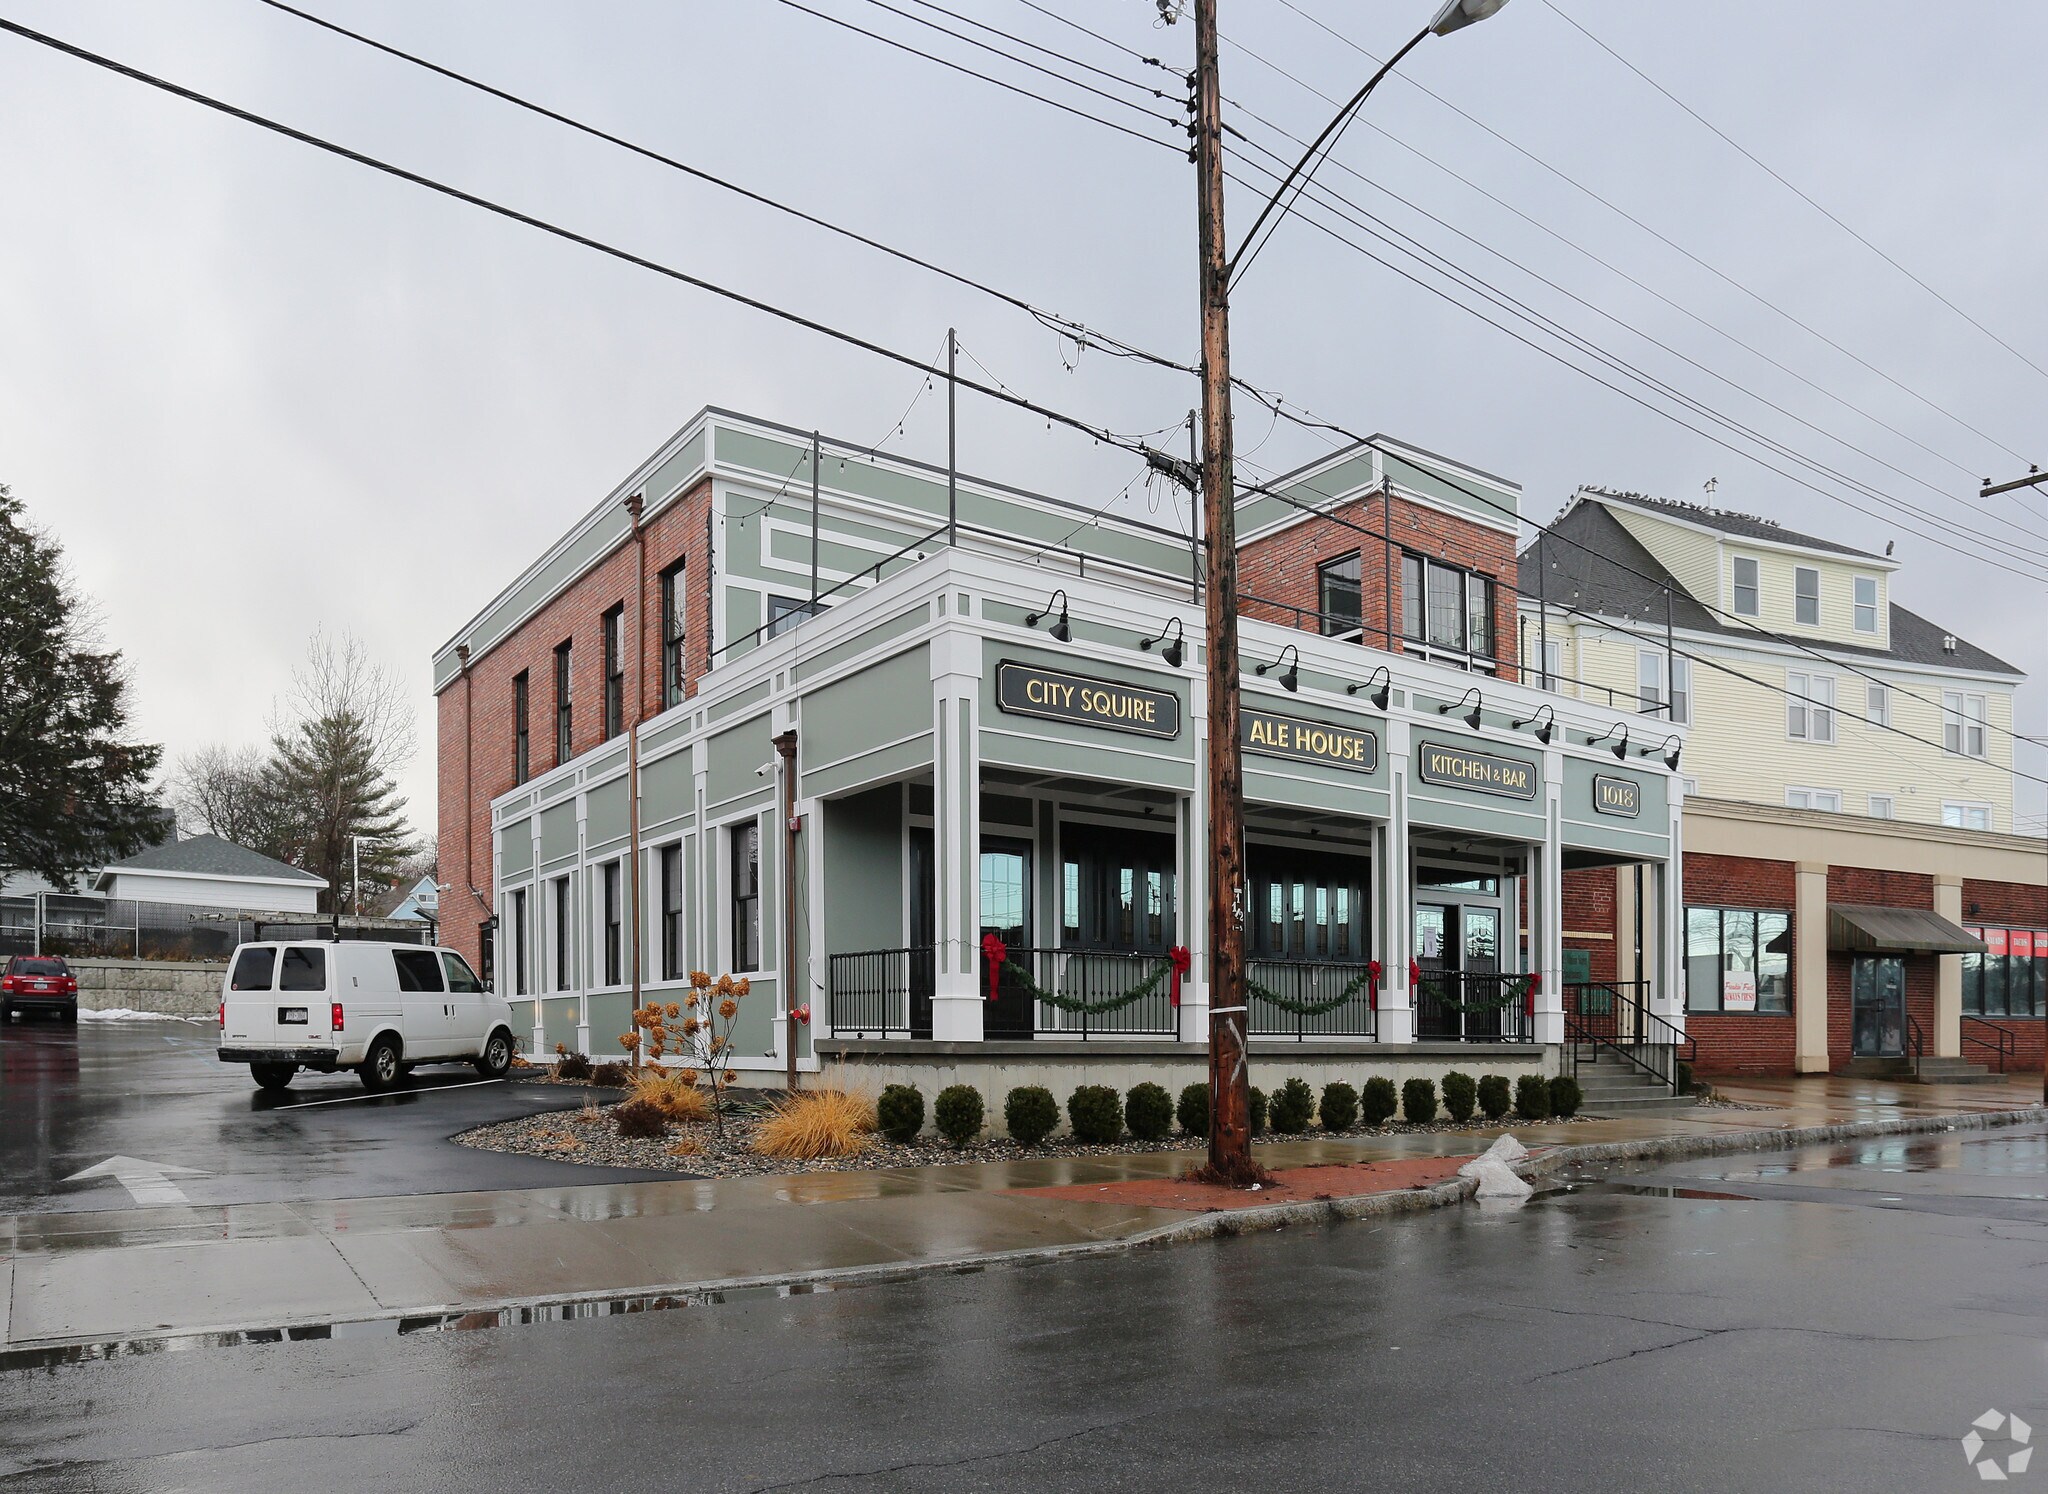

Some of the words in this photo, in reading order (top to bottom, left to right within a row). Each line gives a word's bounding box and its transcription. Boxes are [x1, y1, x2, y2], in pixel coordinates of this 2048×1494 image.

[1026, 679, 1075, 708] CITY
[1080, 688, 1156, 723] SQUIRE
[1250, 719, 1289, 748] ALE
[1295, 726, 1365, 762] HOUSE
[1431, 754, 1491, 782] KITCHEN
[1493, 769, 1501, 781] &
[1503, 768, 1527, 789] BAR
[1602, 785, 1634, 808] 1018
